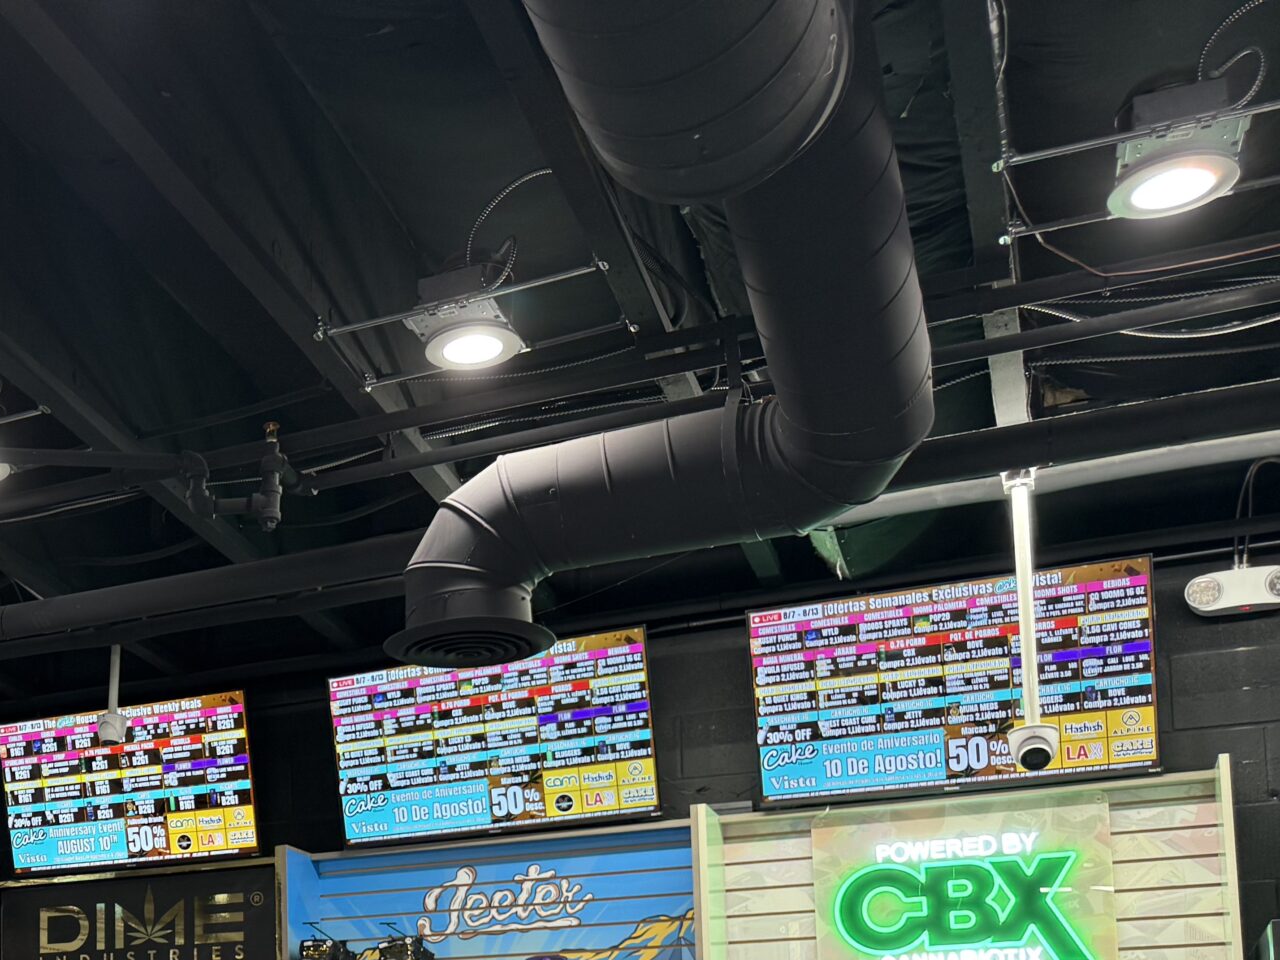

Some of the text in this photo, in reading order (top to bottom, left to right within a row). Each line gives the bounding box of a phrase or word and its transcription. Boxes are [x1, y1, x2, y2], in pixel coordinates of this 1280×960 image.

[869, 592, 929, 609] Semanales
[932, 582, 993, 601] Exclusivas
[761, 614, 779, 622] LIVE
[782, 607, 819, 620] 8/7 8/13
[338, 679, 353, 687] LIVE
[152, 701, 180, 714] Weekly
[181, 698, 202, 710] Deals
[44, 720, 56, 729] The
[1064, 721, 1103, 735] Hashish
[1112, 726, 1152, 736] ALPINE
[766, 728, 812, 744] 30% OFF
[823, 732, 940, 755] Evento de Aniversario
[763, 743, 819, 771] Cake
[823, 748, 942, 778] 10 De Agosto!
[346, 779, 383, 794] 30% OFF
[770, 775, 816, 790] Vista
[391, 783, 485, 803] Evento de Aniversario
[344, 793, 389, 817] Cake
[393, 797, 487, 824] 10 De Agosto!
[13, 816, 43, 828] 30% OFF
[351, 821, 388, 834] Vista
[12, 828, 48, 849] Cake
[48, 824, 96, 839] Anniversary
[56, 837, 96, 855] AUGUST
[875, 831, 1040, 865] POWERED BY
[416, 864, 594, 943] Jeeter
[39, 884, 245, 955] DIME
